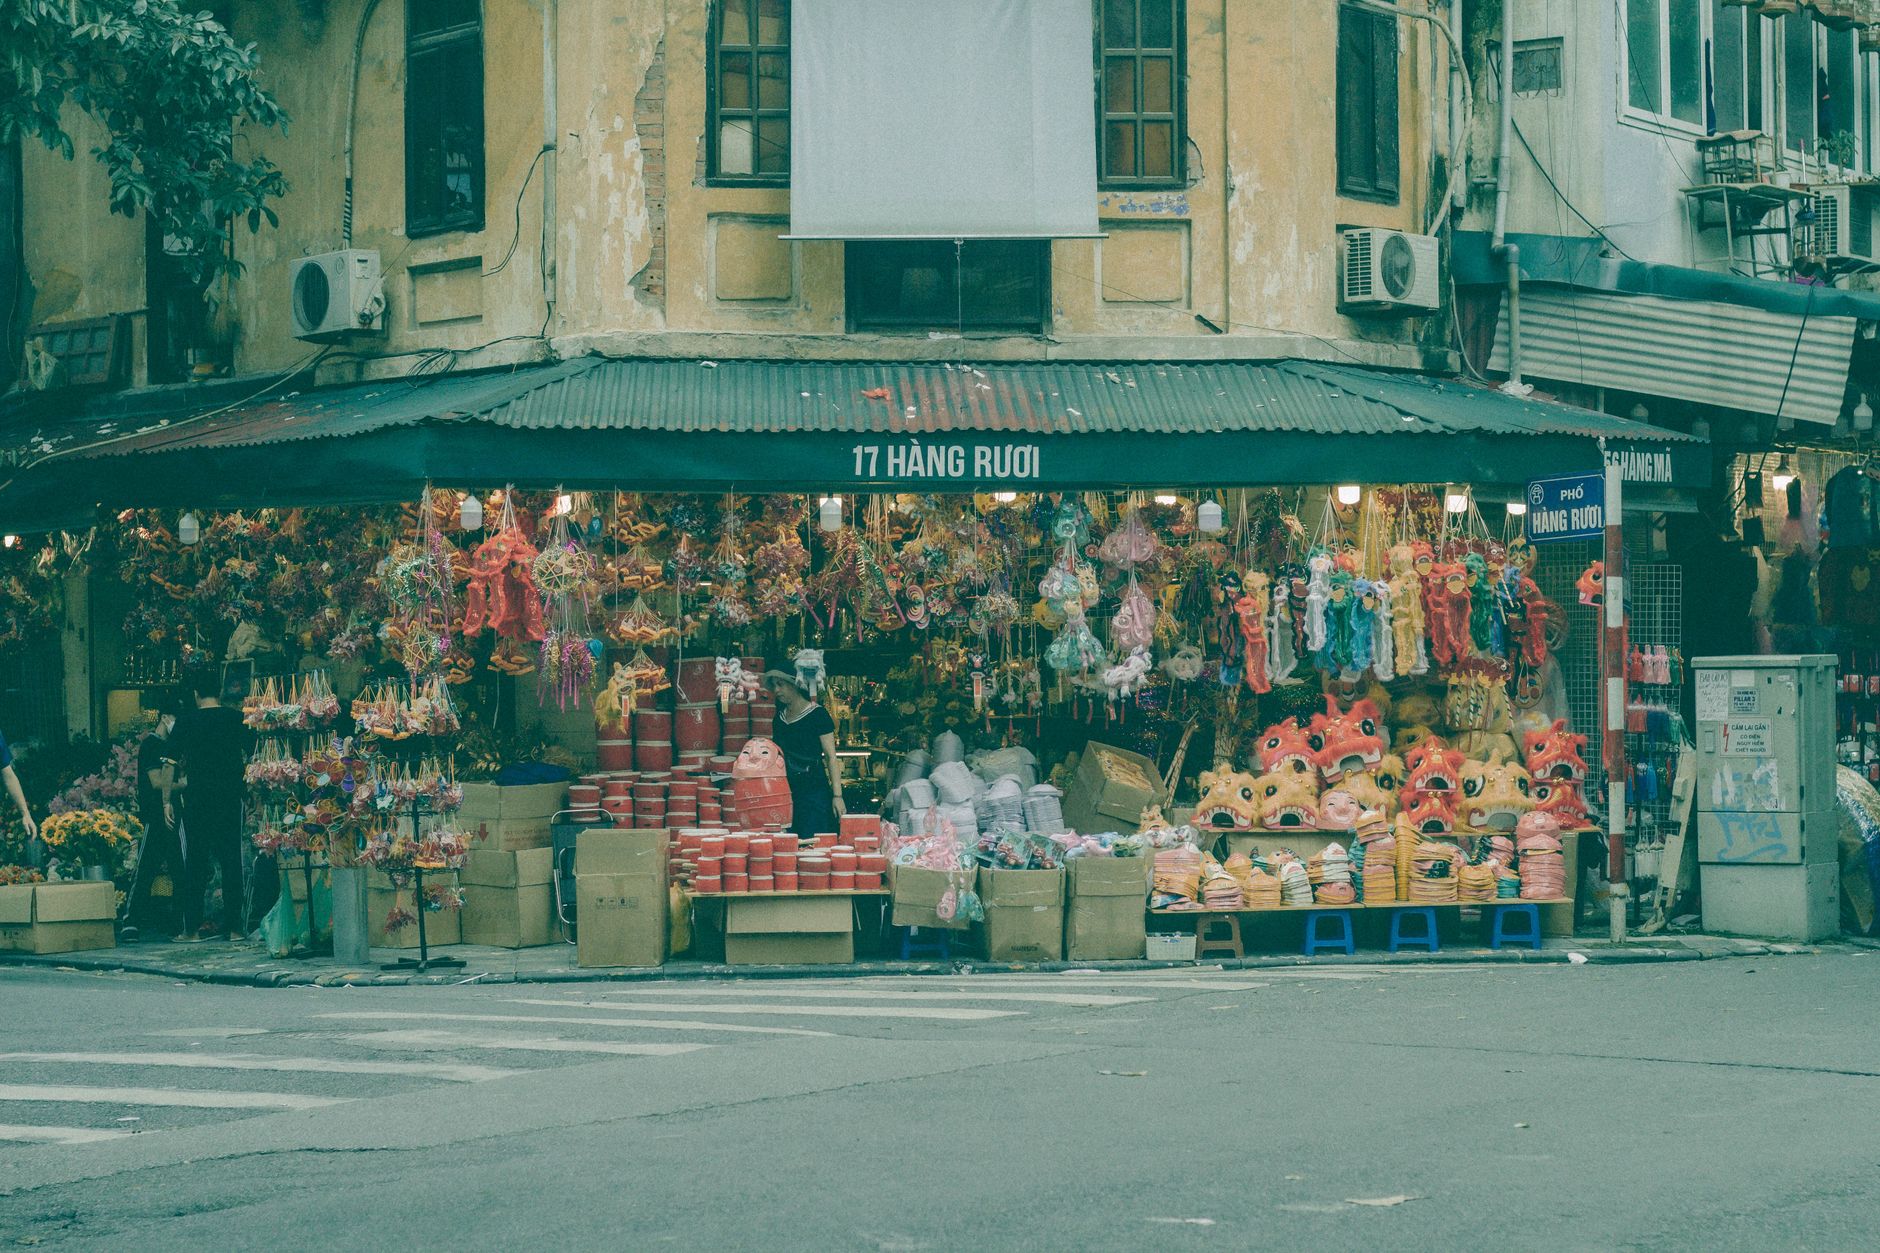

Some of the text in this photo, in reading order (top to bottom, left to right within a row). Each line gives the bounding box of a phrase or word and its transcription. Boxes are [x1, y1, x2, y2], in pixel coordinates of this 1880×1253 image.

[853, 438, 1040, 478] 17 HÀNG RƯƠI
[1620, 445, 1653, 482] HÀNG
[1653, 446, 1673, 483] MÃ
[1560, 482, 1584, 501] PHỐ
[1532, 504, 1603, 535] HÀNG RƯƠI
